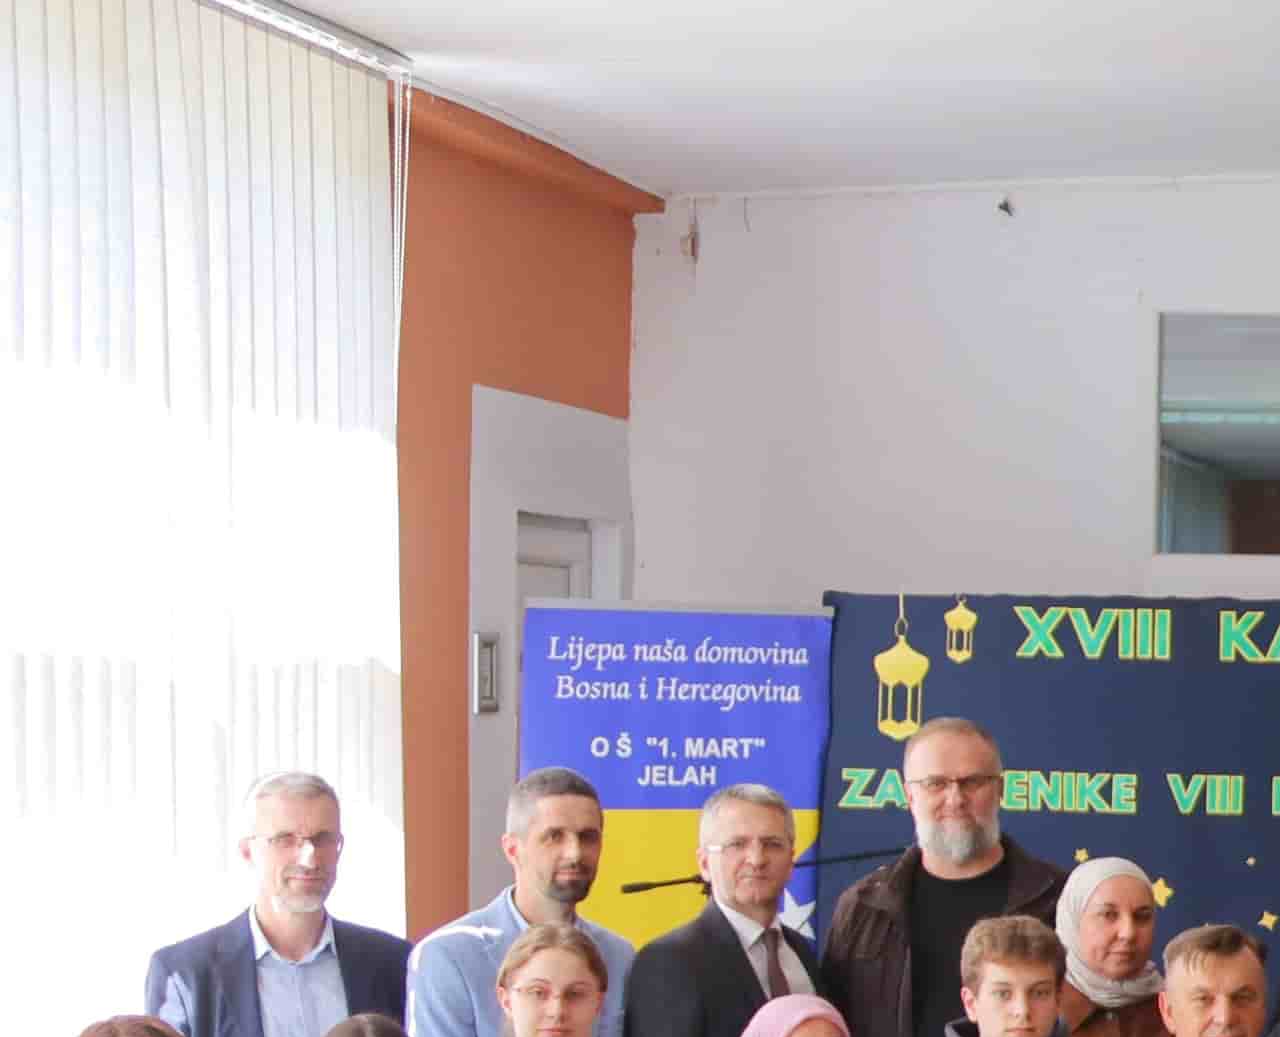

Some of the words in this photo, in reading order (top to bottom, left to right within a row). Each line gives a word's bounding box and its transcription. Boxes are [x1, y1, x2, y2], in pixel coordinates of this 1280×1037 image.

[1014, 604, 1173, 660] XVIII
[548, 636, 626, 671] Lijepa
[633, 638, 688, 662] naša
[695, 637, 809, 666] domovina
[555, 675, 632, 700] Bosna
[639, 677, 649, 699] i
[656, 677, 802, 711] Hercegovina
[685, 736, 766, 760] MART"
[637, 764, 717, 786] JELAH
[838, 767, 909, 808] ZA
[1000, 769, 1138, 814] ENIKE
[1166, 773, 1245, 816] VIII
